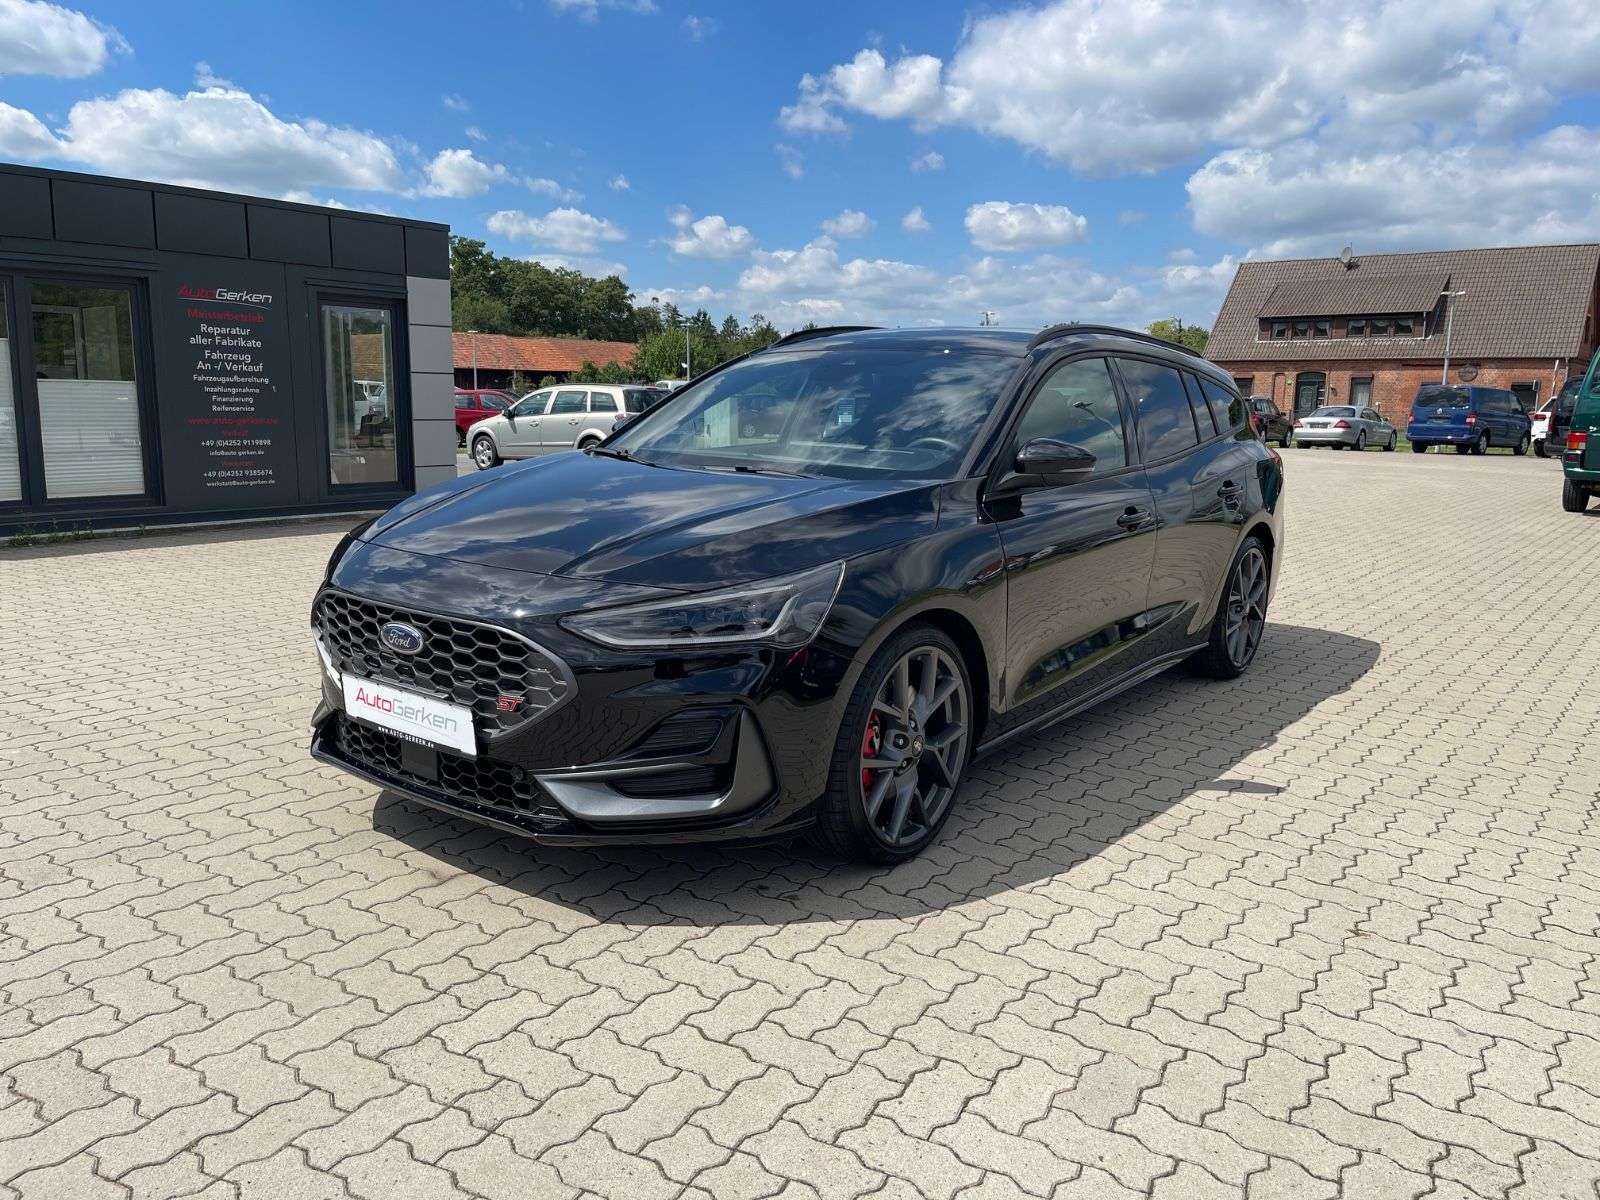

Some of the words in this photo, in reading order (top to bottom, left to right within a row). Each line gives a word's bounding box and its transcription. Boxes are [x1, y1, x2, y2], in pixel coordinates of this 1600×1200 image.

[176, 283, 273, 304] AutoGerken
[200, 323, 251, 336] Reparatur
[189, 335, 212, 345] aller
[215, 336, 262, 348] Fabrikate
[205, 350, 251, 363] Fahrzeug
[197, 361, 211, 370] An
[224, 361, 263, 372] Verkauf
[193, 374, 269, 384] Fahrzeugaufbereitung
[204, 386, 260, 394] Inzahlungsnahme
[212, 395, 253, 403] Finanzierung
[388, 629, 411, 648] Ford
[355, 687, 458, 732] AutoGerken
[496, 694, 527, 712] ST
